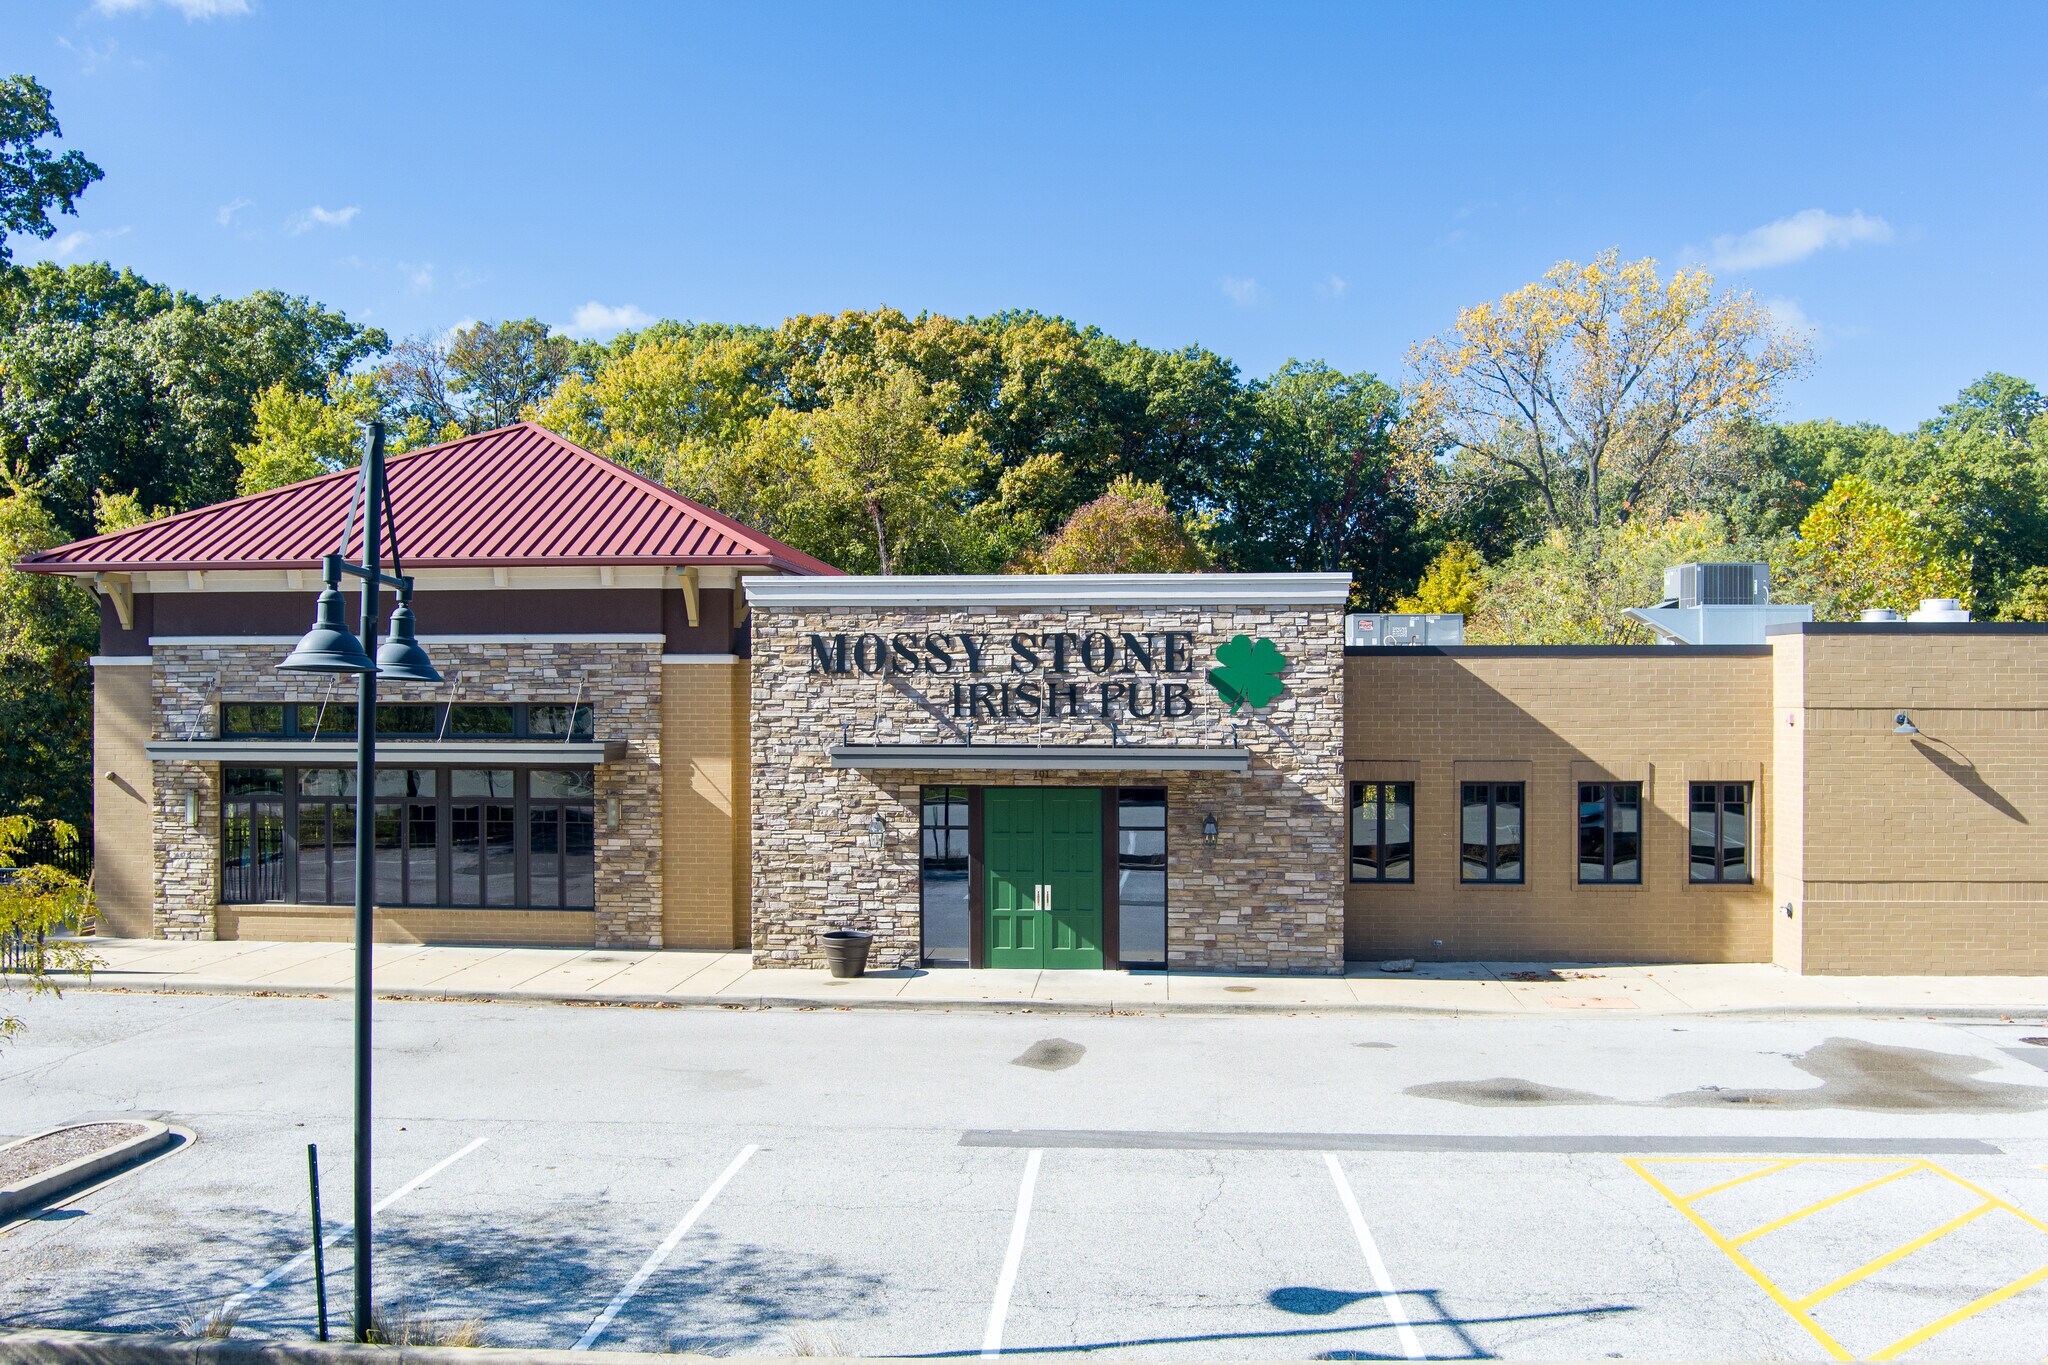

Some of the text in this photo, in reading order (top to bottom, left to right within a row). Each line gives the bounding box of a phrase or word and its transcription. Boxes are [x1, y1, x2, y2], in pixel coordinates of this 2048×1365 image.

[806, 632, 1192, 675] MOSSY STONE
[953, 682, 1192, 717] IRISH PUB
